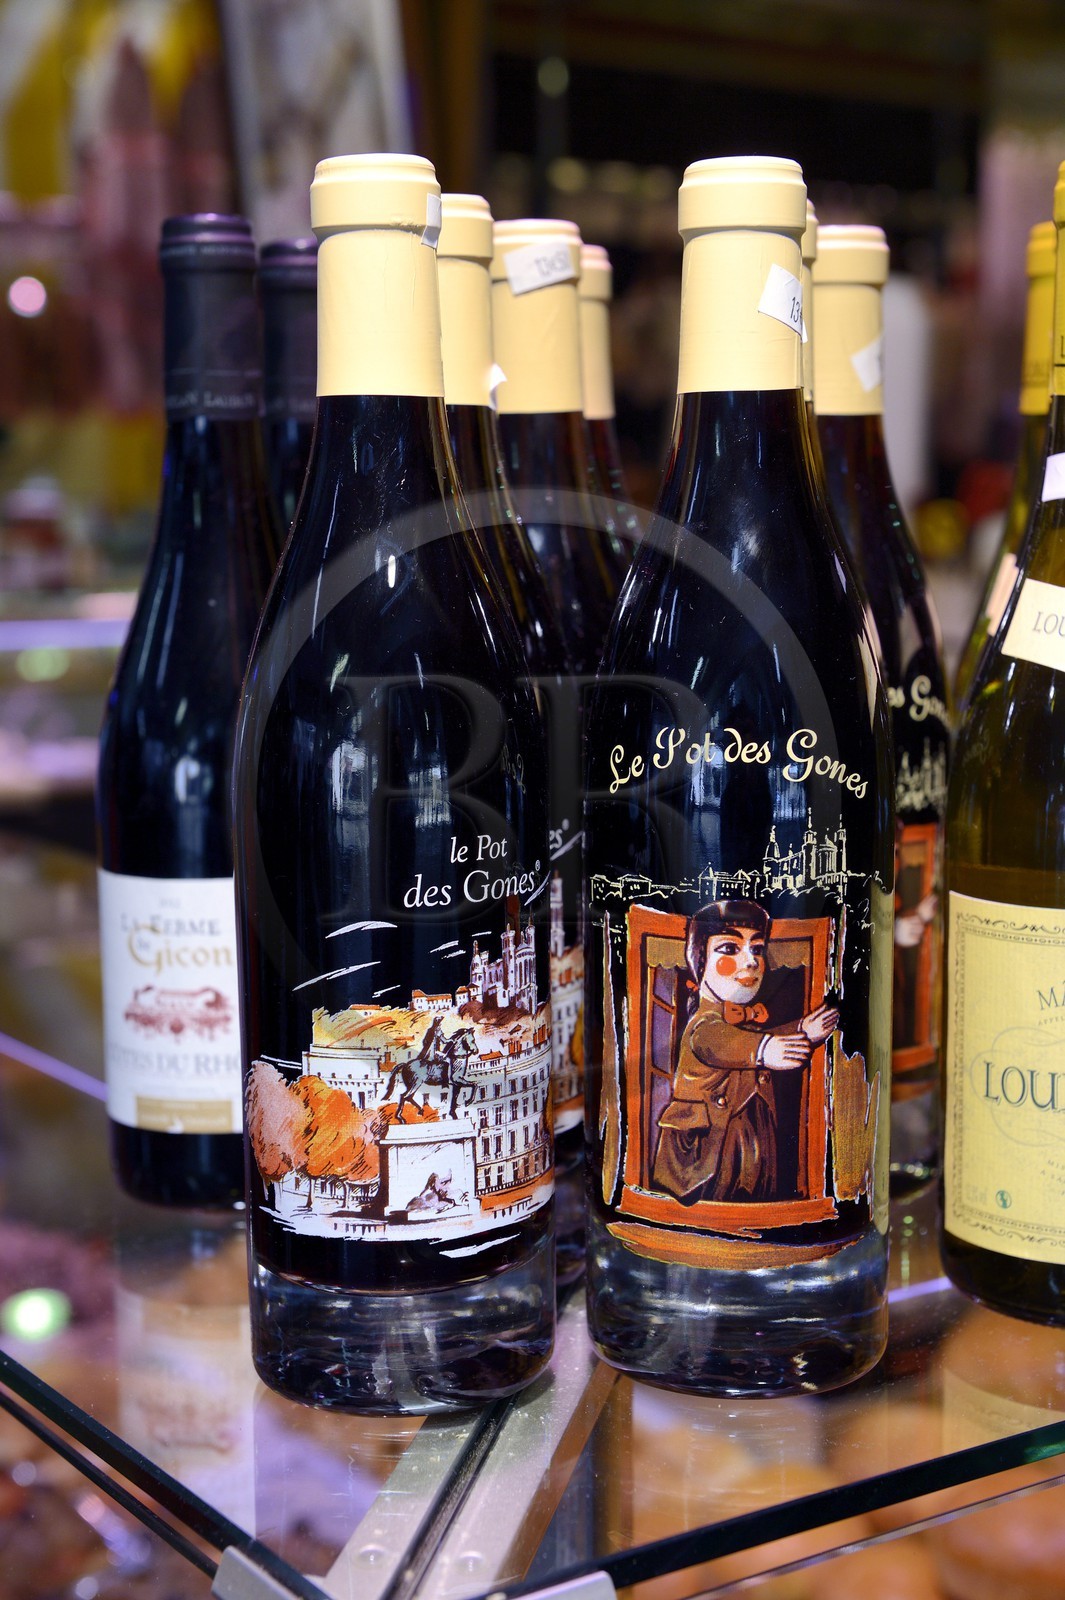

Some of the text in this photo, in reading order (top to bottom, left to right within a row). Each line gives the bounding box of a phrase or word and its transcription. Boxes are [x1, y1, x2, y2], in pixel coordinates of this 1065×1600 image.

[609, 726, 869, 799] Le Pot des Gones
[450, 834, 508, 864] le Pot
[403, 873, 452, 909] des
[983, 1060, 1065, 1113] LOU
